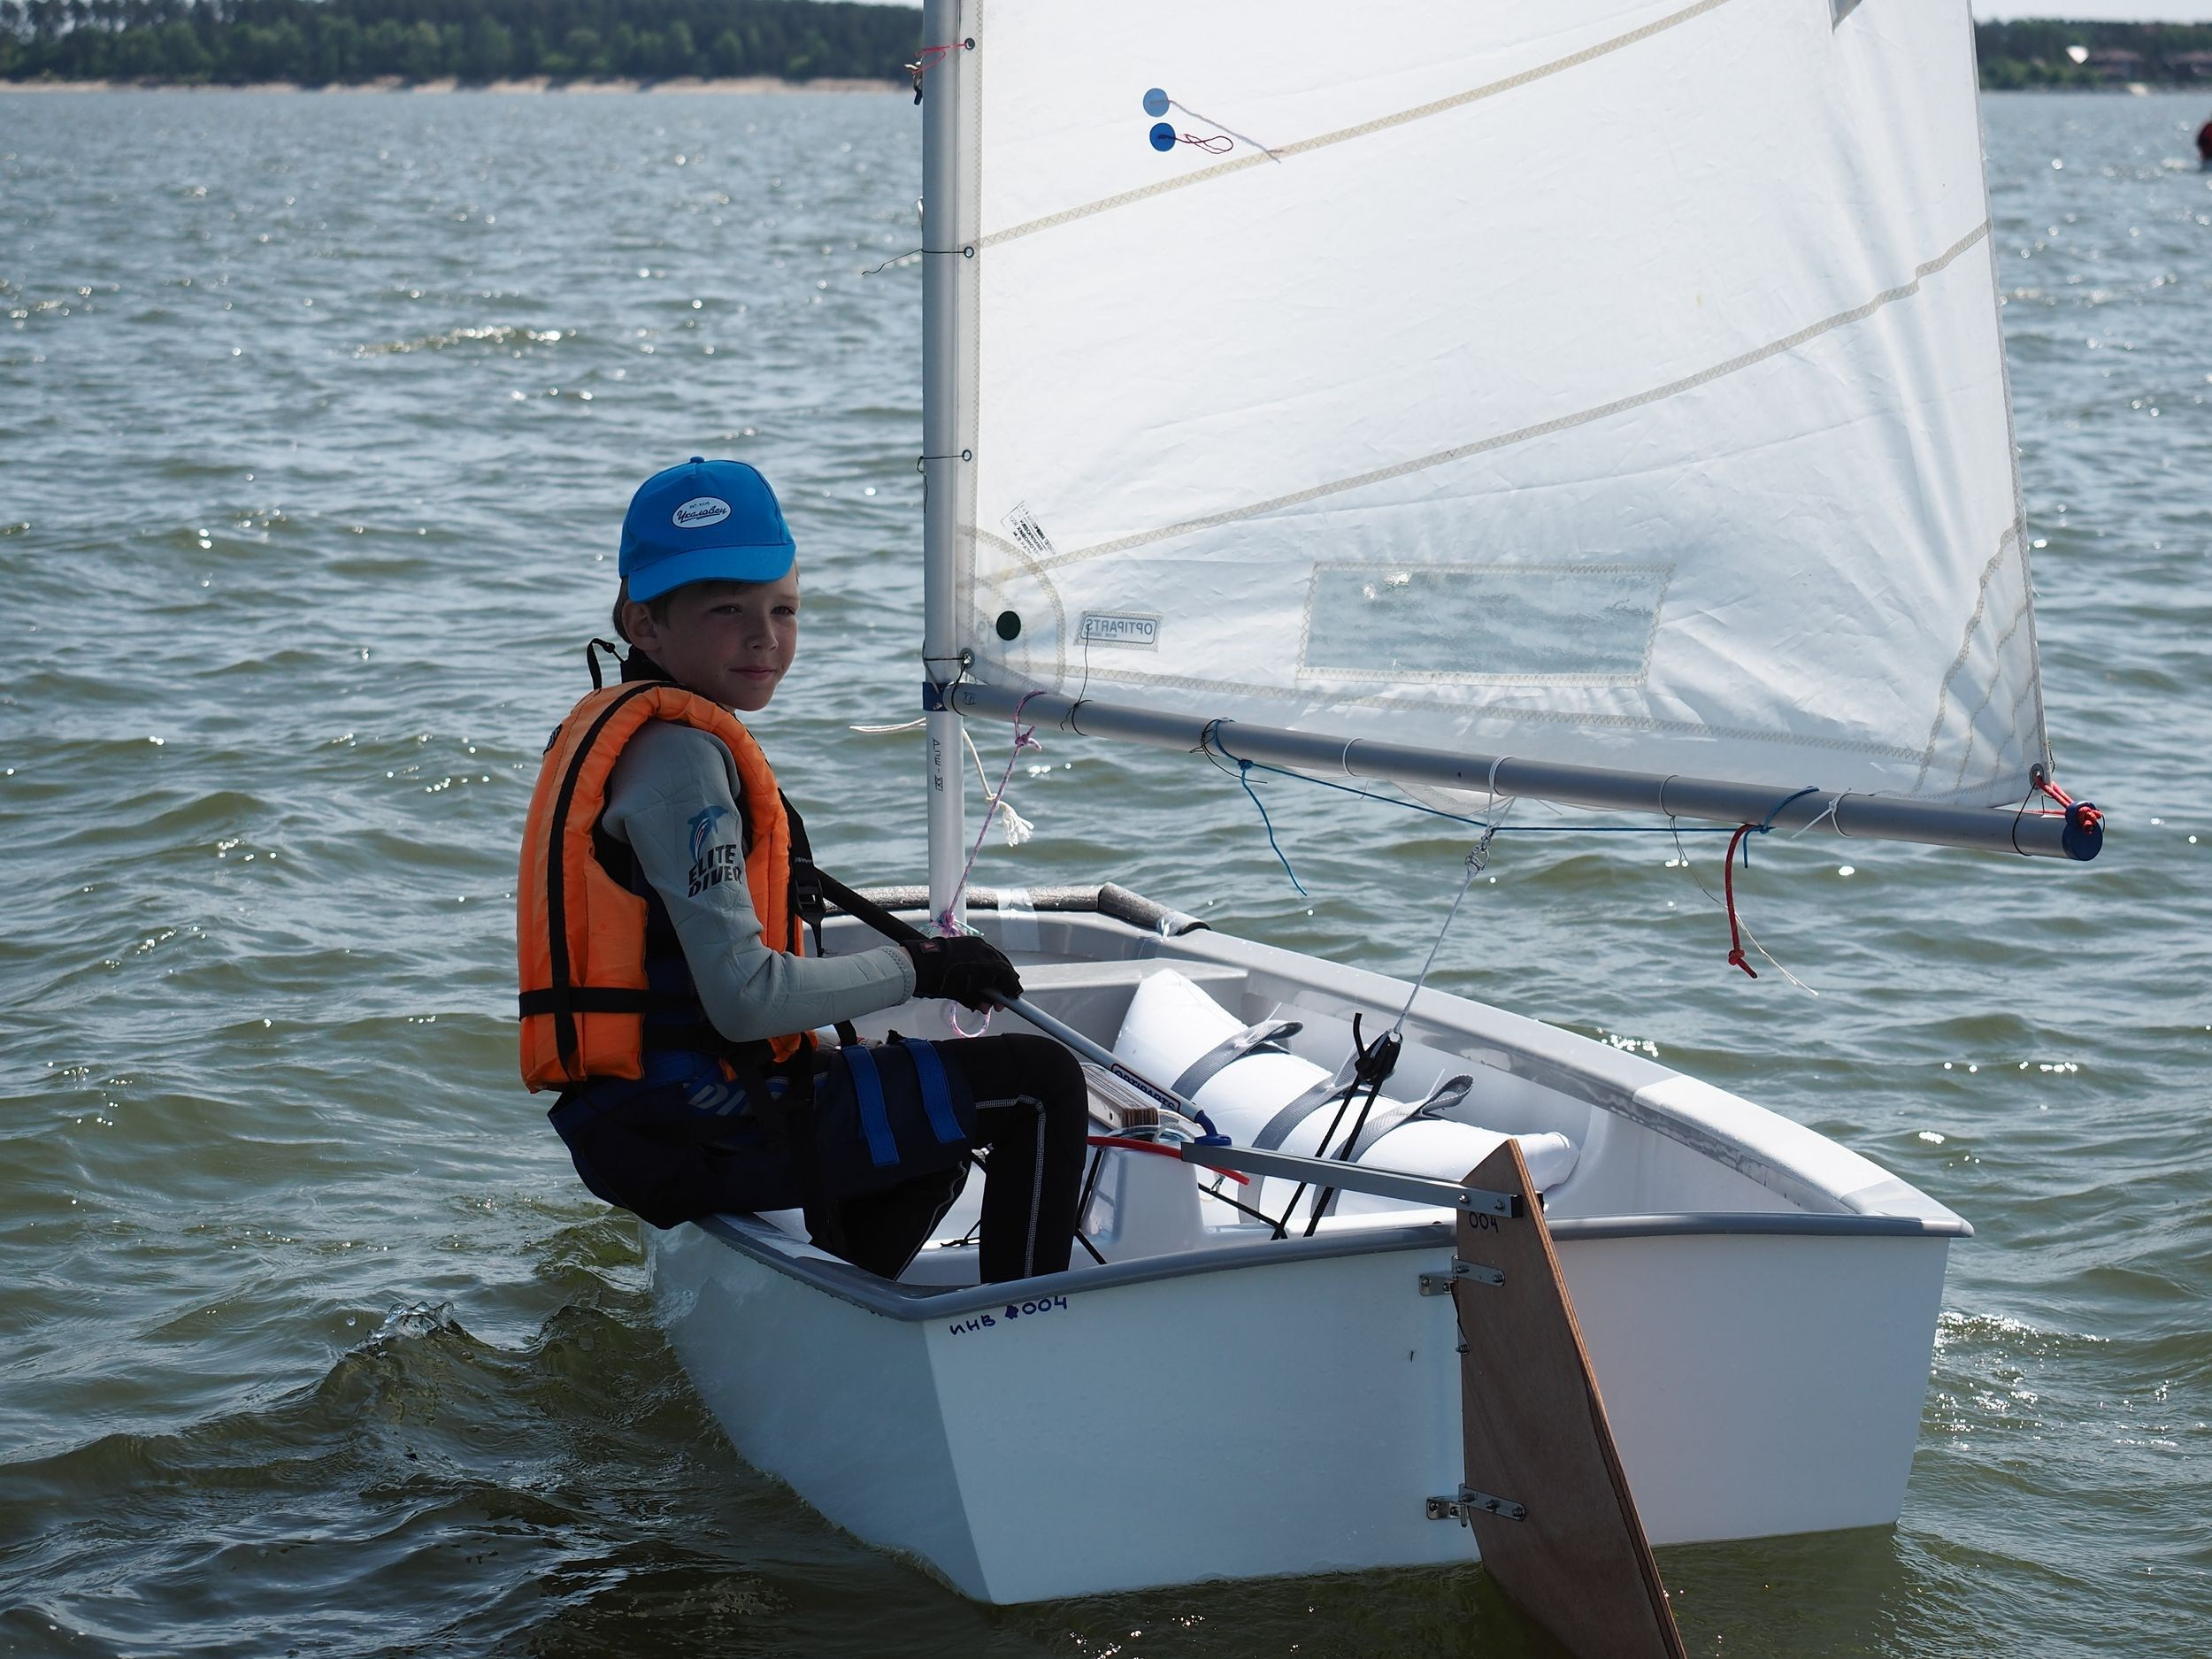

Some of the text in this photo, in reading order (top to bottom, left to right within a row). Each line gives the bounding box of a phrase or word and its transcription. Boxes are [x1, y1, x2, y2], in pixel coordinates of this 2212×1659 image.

[688, 844, 737, 886] ELITE
[687, 866, 742, 898] DIVER
[1469, 1211, 1499, 1233] 004
